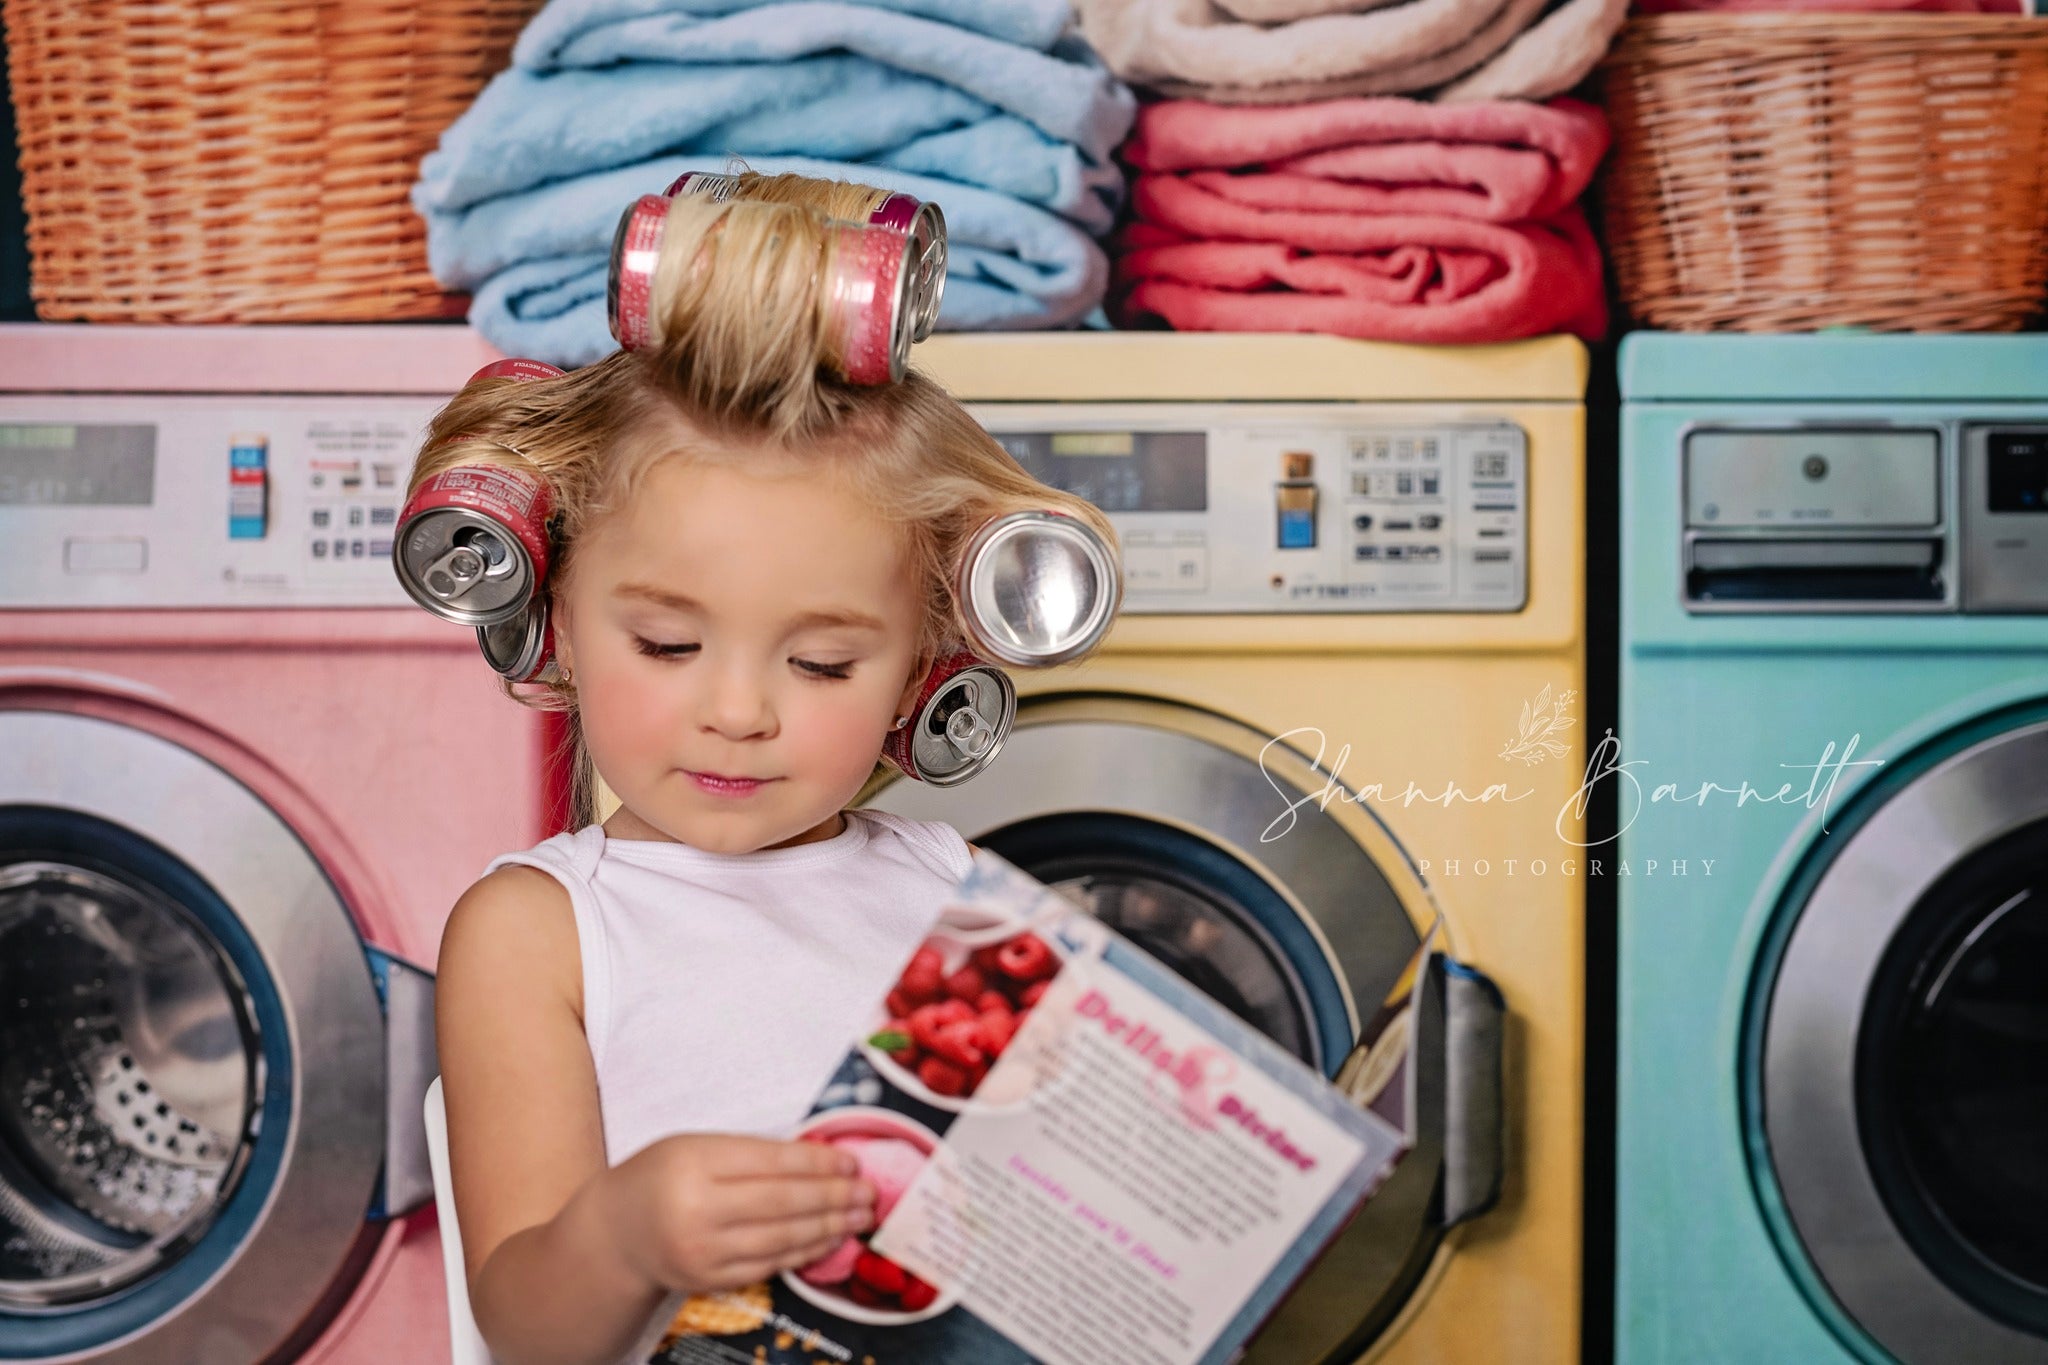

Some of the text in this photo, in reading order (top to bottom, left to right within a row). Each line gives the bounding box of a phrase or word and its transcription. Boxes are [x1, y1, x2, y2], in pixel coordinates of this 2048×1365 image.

[513, 361, 541, 370] RECYCLE
[446, 479, 479, 490] Facts
[480, 481, 530, 515] Nutrition
